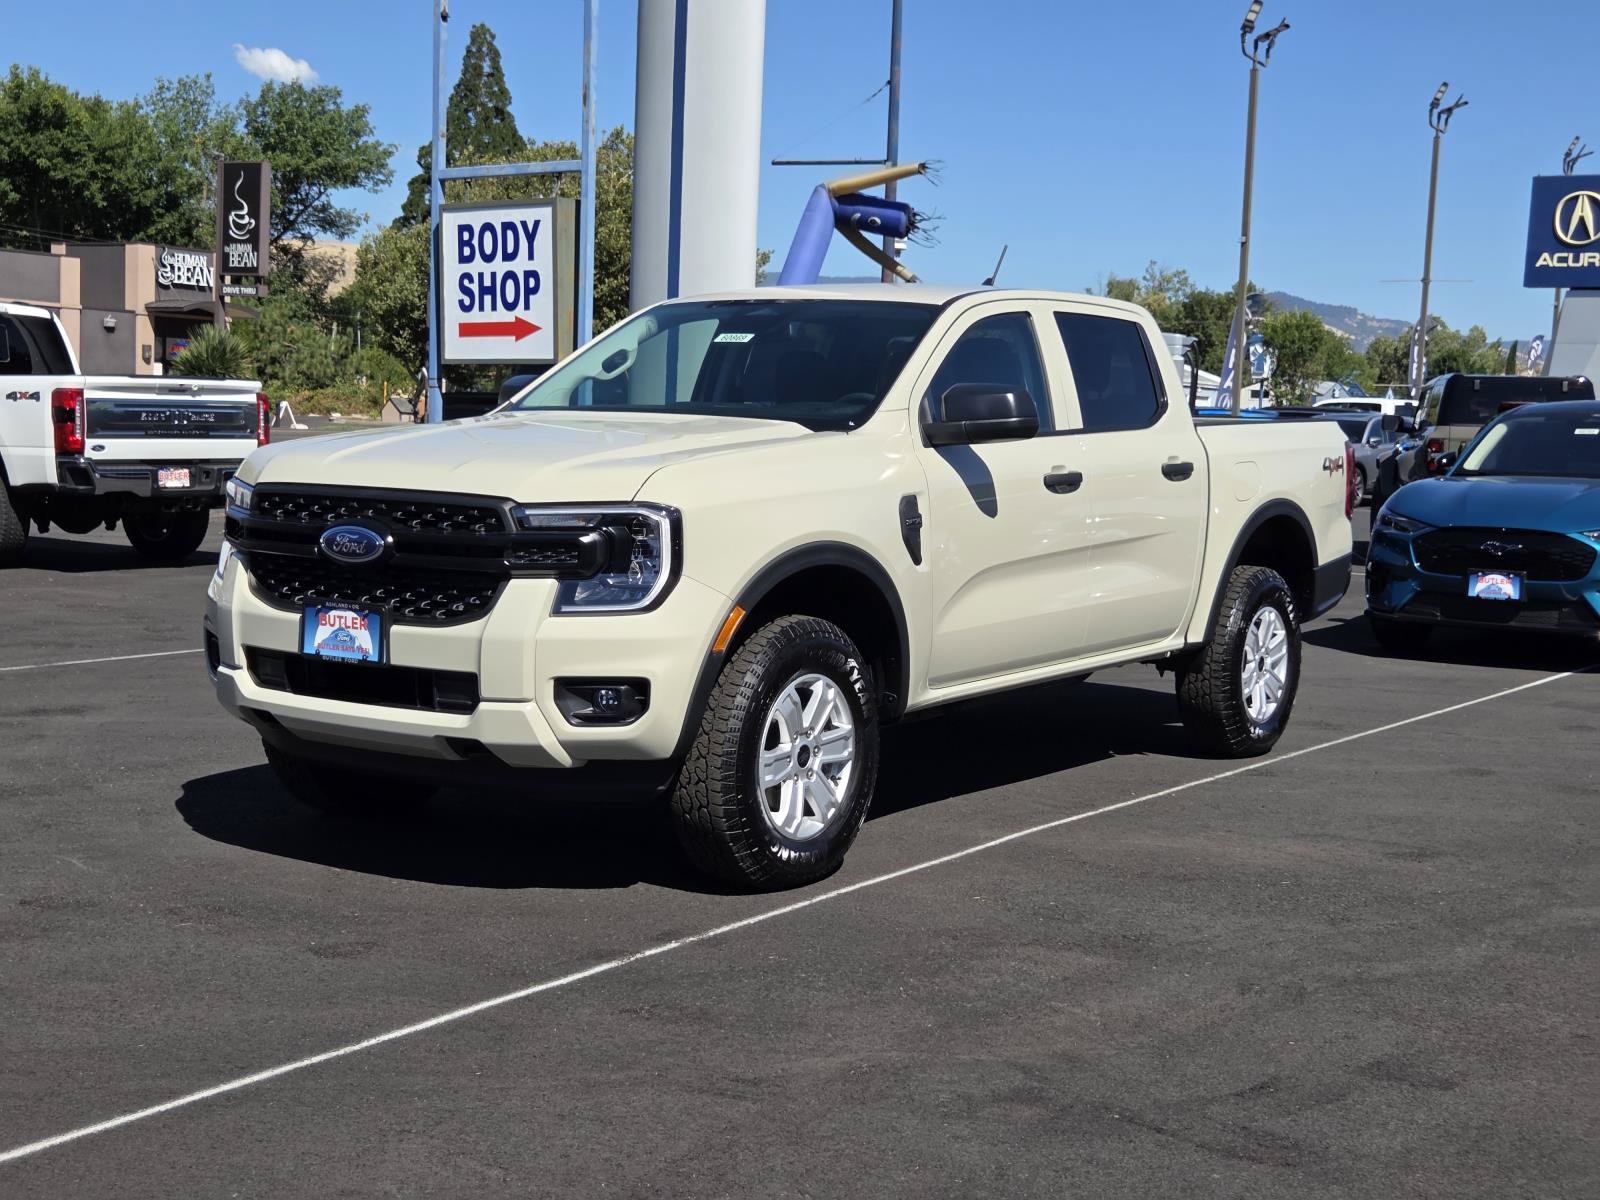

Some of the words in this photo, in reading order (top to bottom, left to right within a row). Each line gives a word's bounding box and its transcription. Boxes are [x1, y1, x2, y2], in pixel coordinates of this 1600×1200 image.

[229, 243, 253, 253] HUMAN
[457, 219, 541, 264] BODY
[174, 252, 207, 268] HUMAN
[229, 252, 258, 268] BEAN
[173, 265, 214, 287] BEAN
[222, 286, 240, 294] DRIVE
[240, 287, 257, 295] THRU
[457, 270, 541, 313] SHOP
[332, 533, 367, 554] Ford
[1478, 576, 1513, 585] BUTLER
[319, 612, 369, 631] BUTLER
